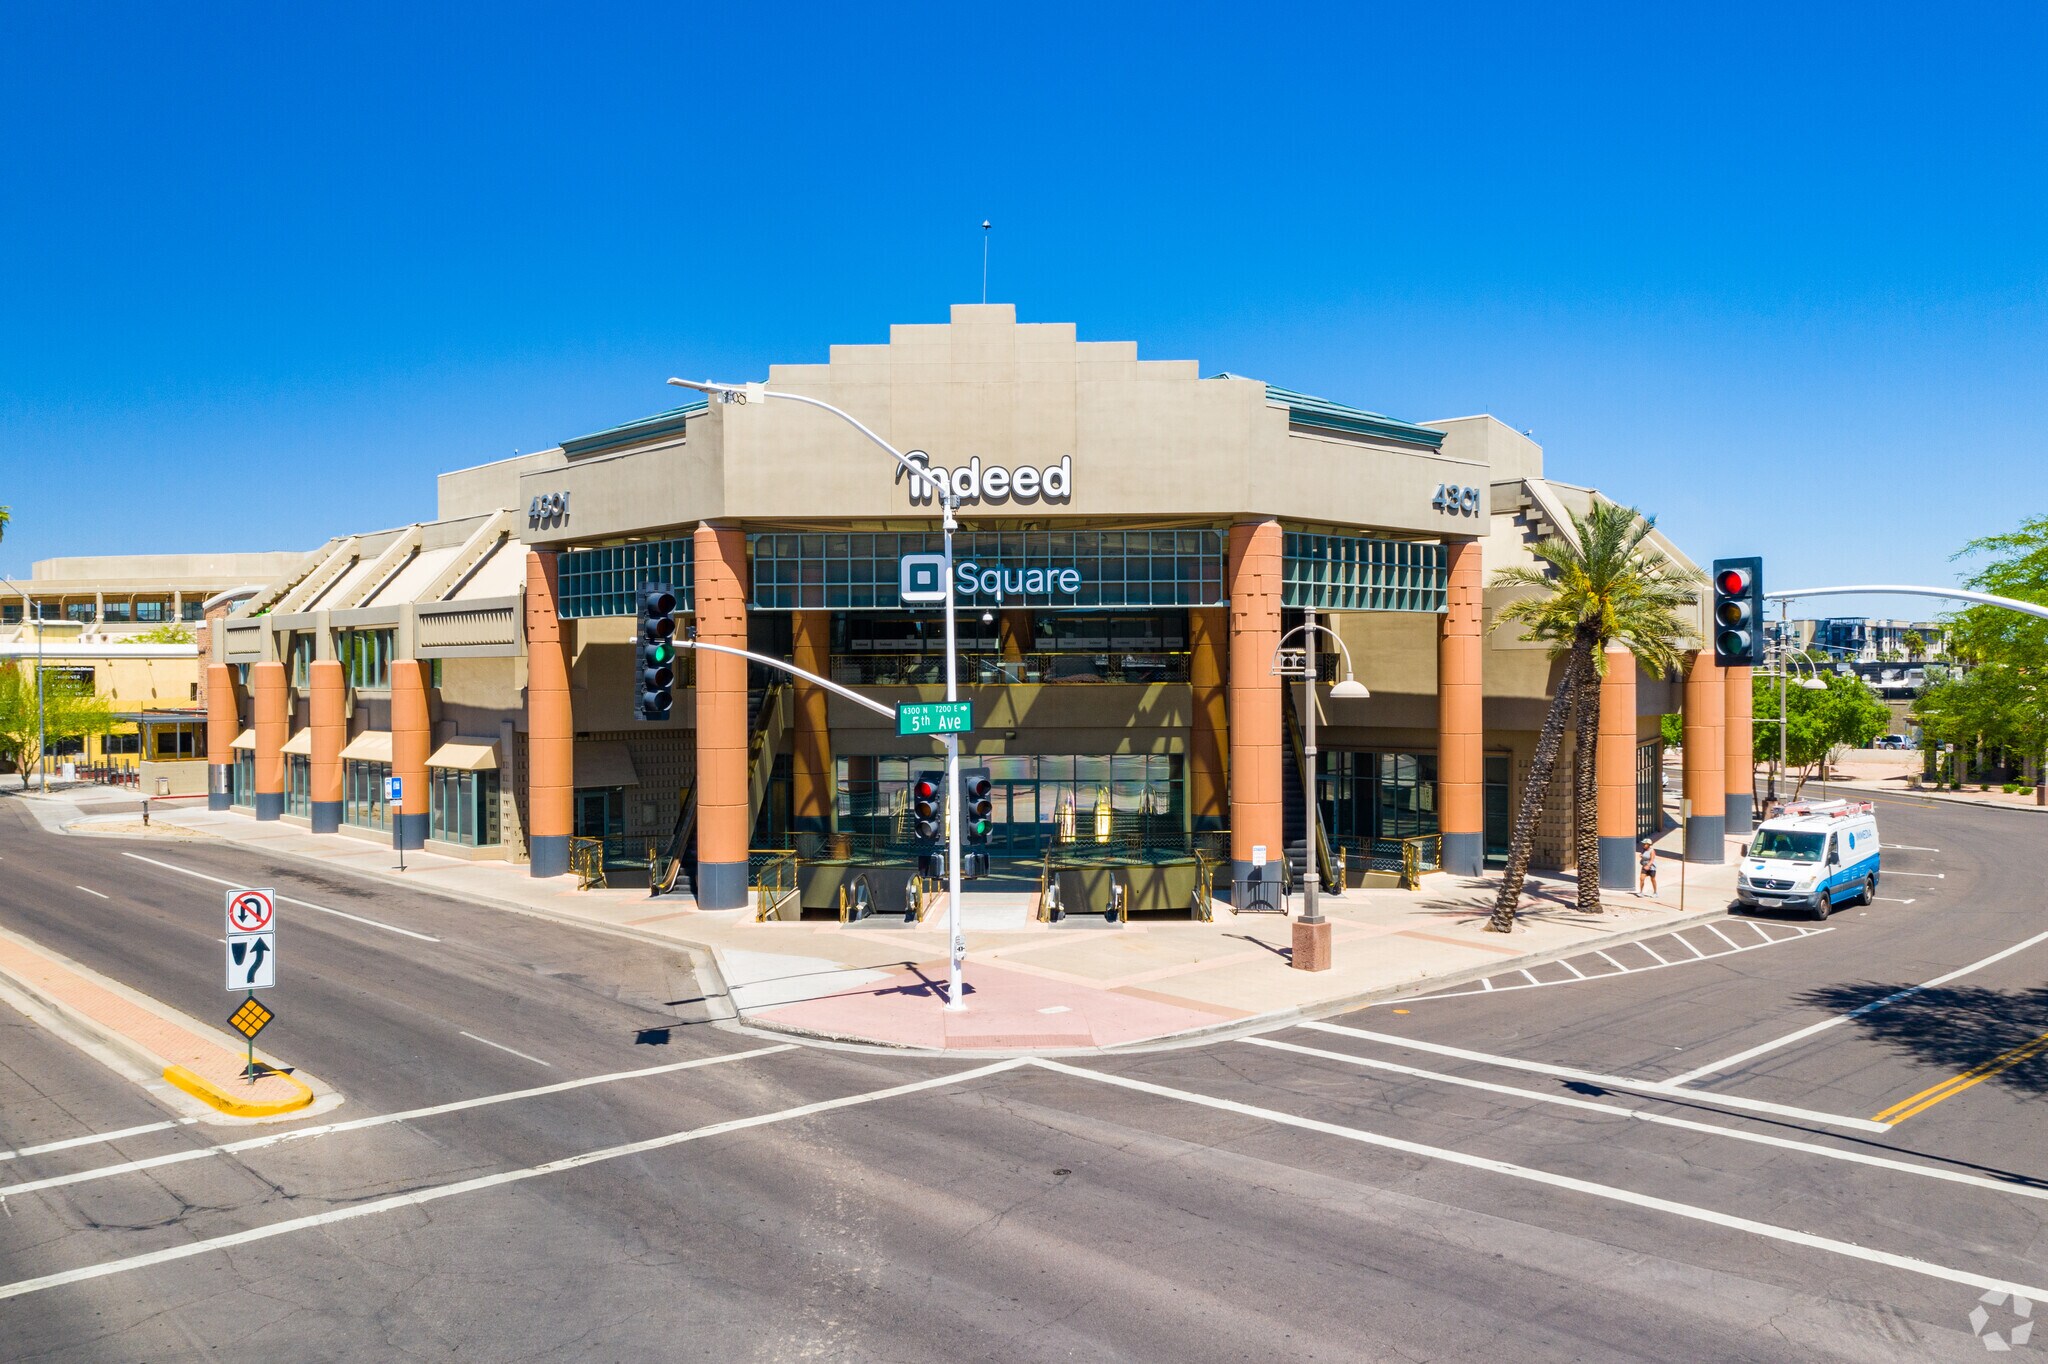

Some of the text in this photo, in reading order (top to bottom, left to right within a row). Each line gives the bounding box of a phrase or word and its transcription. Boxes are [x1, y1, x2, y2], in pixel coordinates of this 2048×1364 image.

[896, 450, 1071, 499] indeed
[528, 491, 570, 518] 4301
[1432, 484, 1480, 511] 4301
[956, 562, 1081, 601] Square
[903, 707, 920, 715] 4300
[935, 705, 951, 713] 7200
[912, 715, 961, 731] 5th Ave
